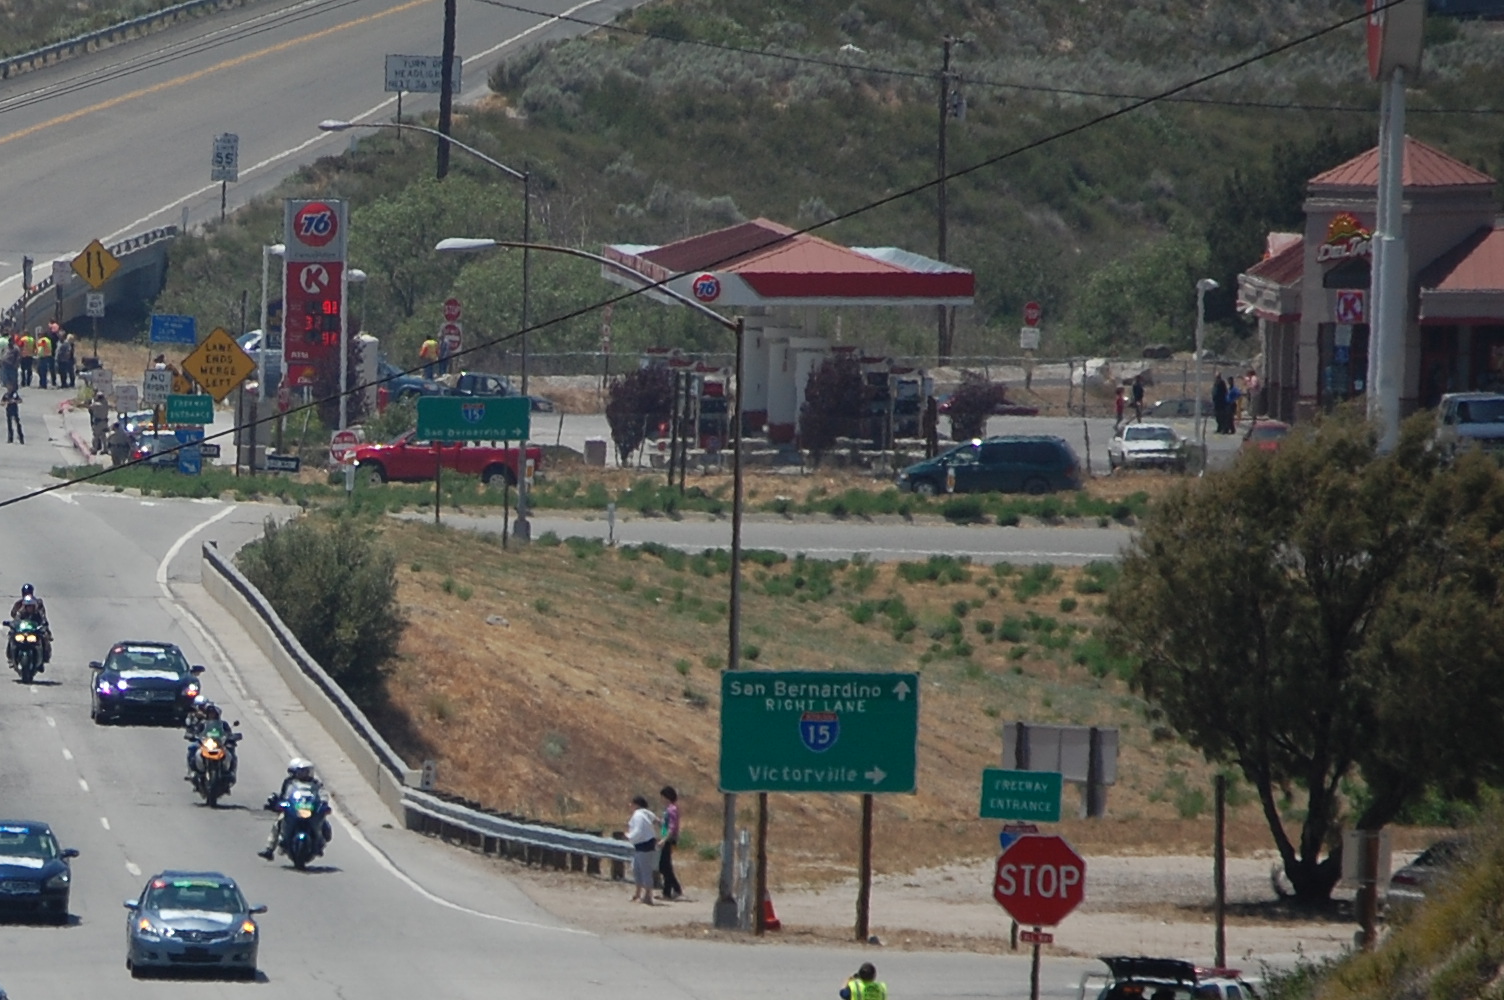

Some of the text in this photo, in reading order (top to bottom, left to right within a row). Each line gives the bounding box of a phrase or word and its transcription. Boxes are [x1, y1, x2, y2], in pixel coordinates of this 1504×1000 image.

[215, 152, 234, 164] 55
[300, 210, 332, 236] 76
[698, 281, 716, 296] 76
[206, 343, 233, 352] LANE
[206, 355, 233, 364] ENDS
[150, 373, 165, 383] NO
[200, 366, 236, 376] MERGE
[205, 378, 231, 388] LEFT
[730, 680, 882, 698] San Bernardino
[765, 698, 866, 713] RIGHT LANE
[808, 724, 830, 745] 15
[748, 764, 858, 783] Victorville
[994, 778, 1049, 793] FREEWAY
[990, 798, 1052, 813] ENTRANCE
[998, 864, 1080, 899] STOP
